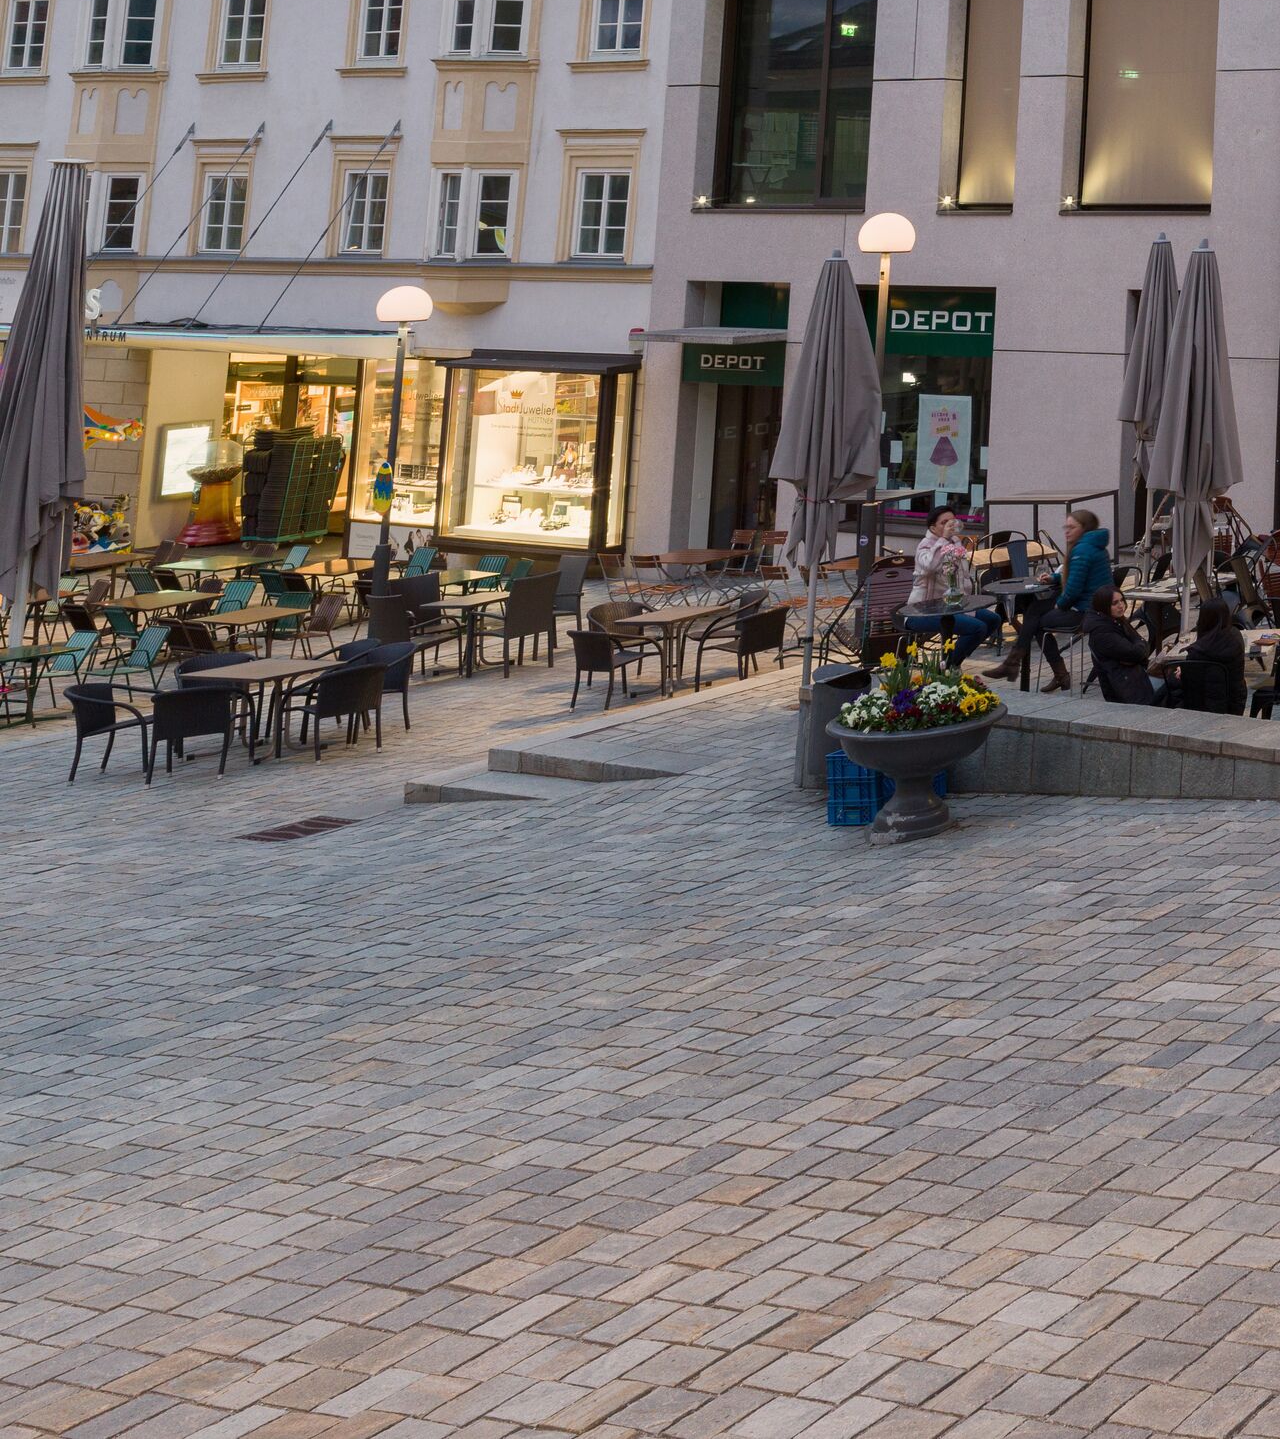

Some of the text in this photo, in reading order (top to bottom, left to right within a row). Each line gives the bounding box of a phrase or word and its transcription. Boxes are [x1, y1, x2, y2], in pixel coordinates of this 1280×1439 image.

[891, 309, 993, 332] DEPOT
[86, 330, 127, 342] NTRUM
[700, 354, 765, 369] DEPOT
